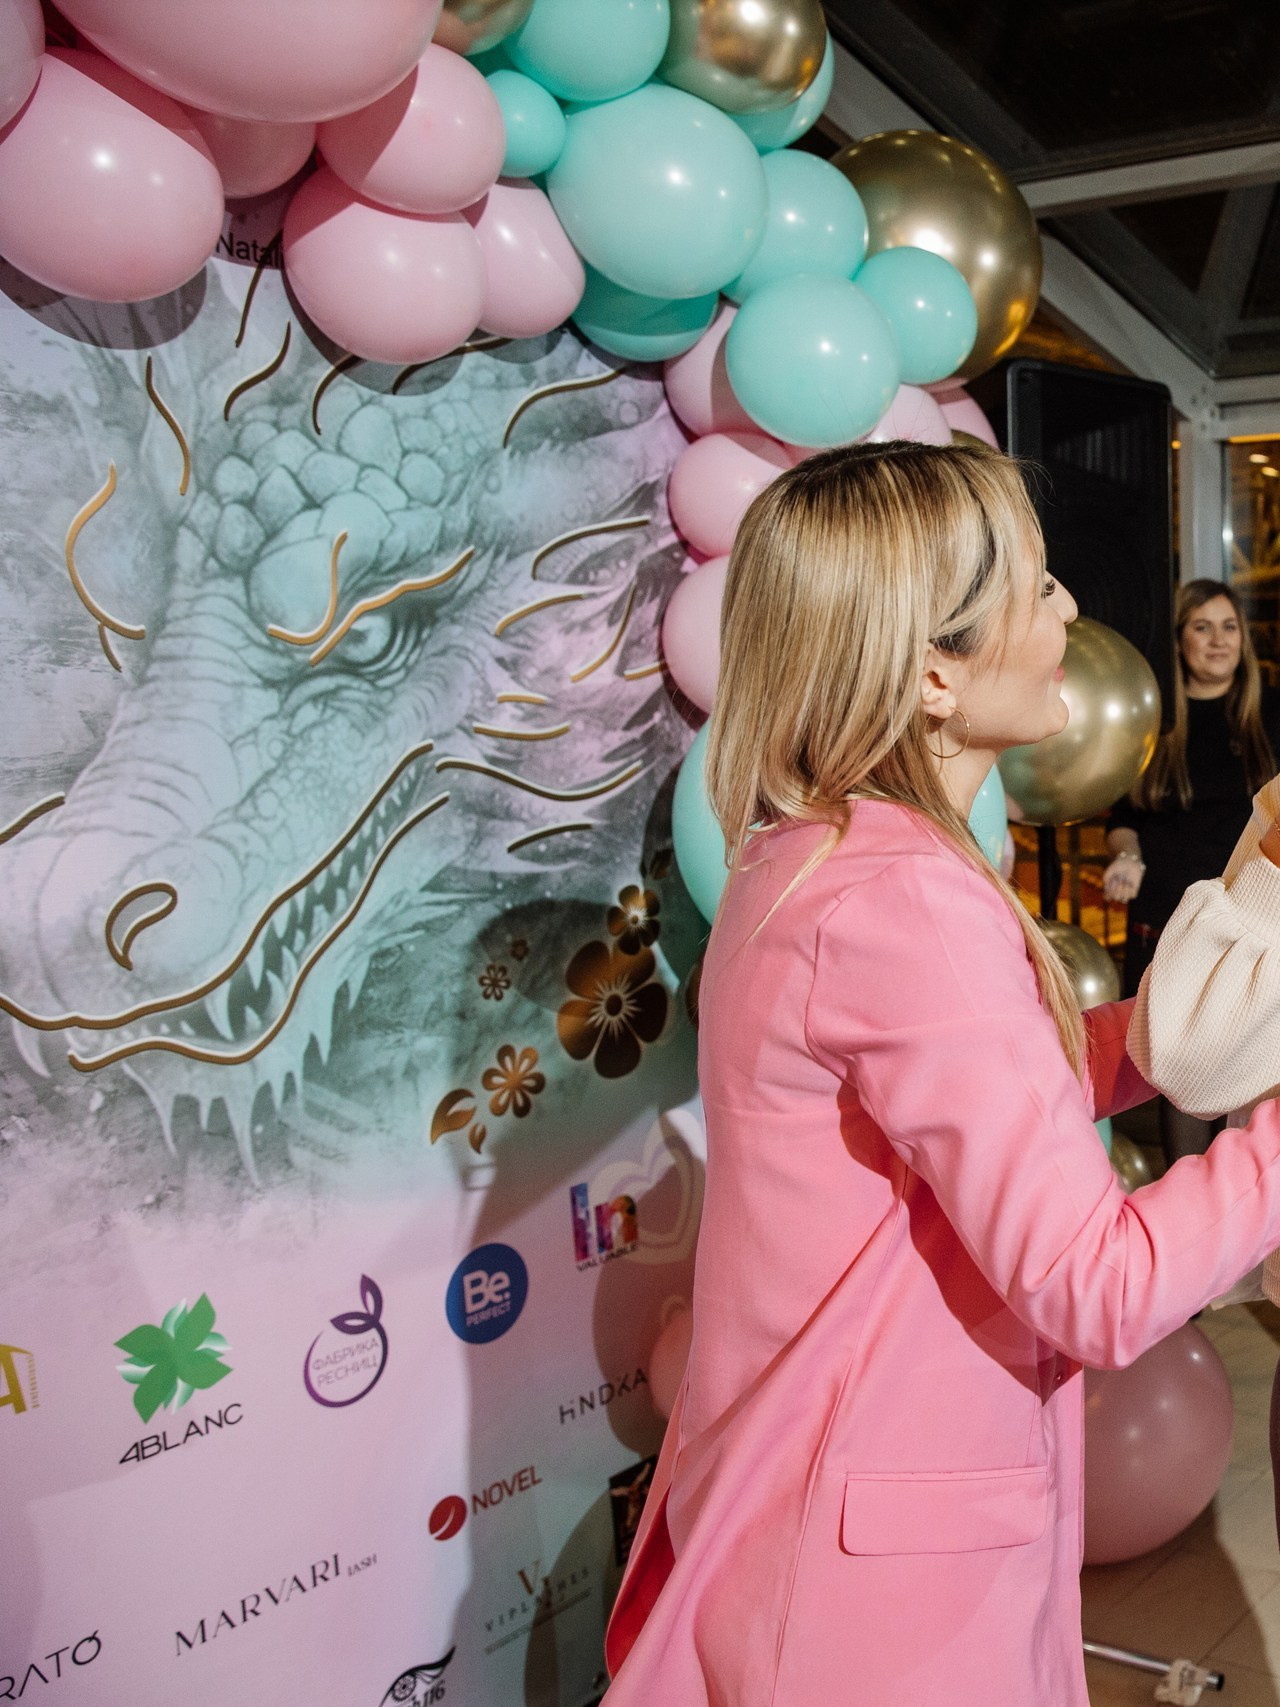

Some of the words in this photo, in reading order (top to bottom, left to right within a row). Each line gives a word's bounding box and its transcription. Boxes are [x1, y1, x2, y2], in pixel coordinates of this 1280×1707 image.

[465, 1300, 512, 1328] PERFECT
[312, 1337, 380, 1371] ФАБРИКА
[316, 1354, 378, 1387] РЕСНИЦ
[471, 1464, 543, 1516] NOVEL
[173, 1551, 341, 1657] MARVARI
